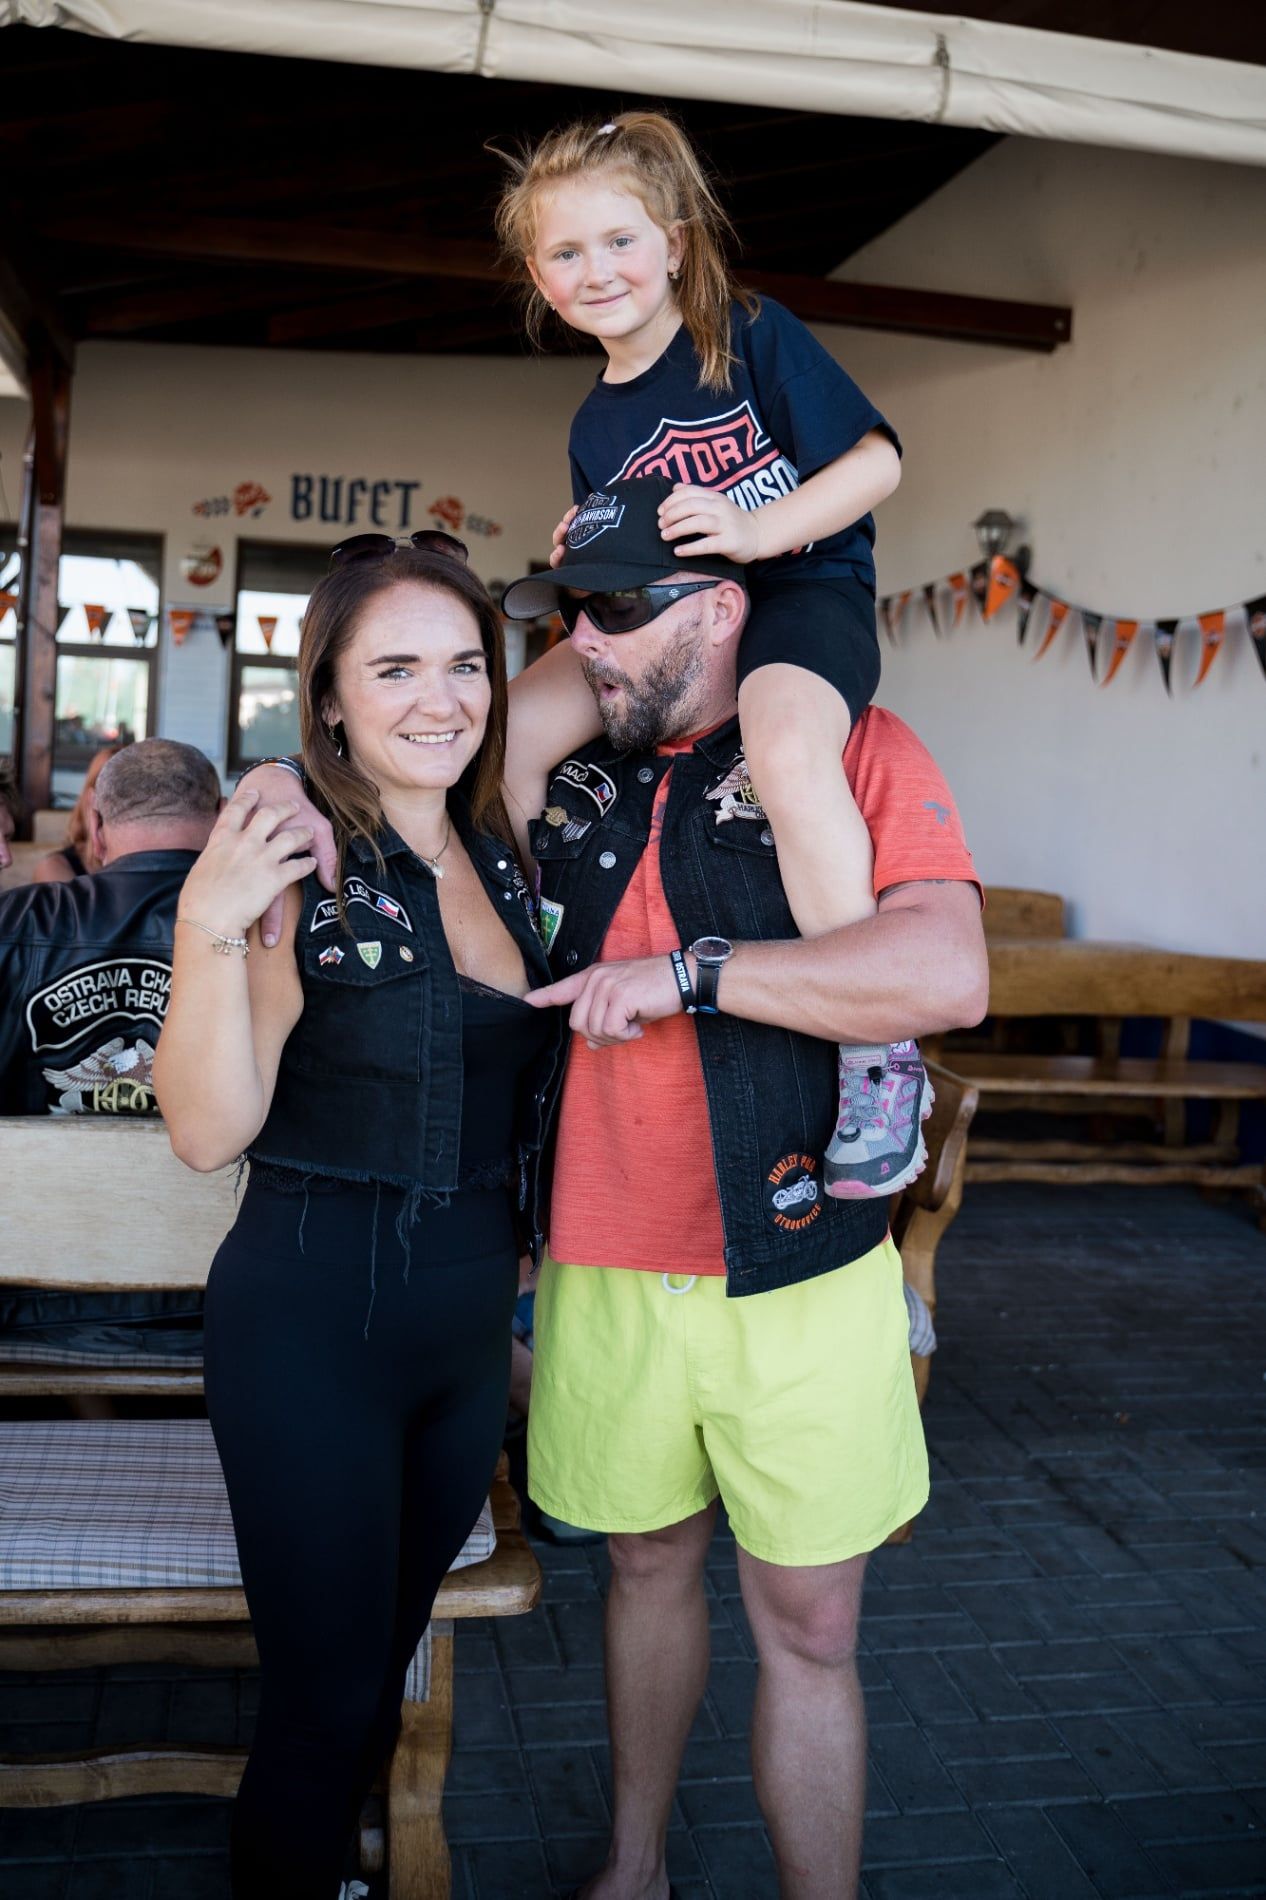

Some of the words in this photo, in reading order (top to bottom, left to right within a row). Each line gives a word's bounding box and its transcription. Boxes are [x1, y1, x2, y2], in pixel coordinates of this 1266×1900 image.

[636, 436, 744, 485] OTOR
[290, 473, 421, 528] BUFET
[349, 884, 371, 901] LISA
[44, 967, 133, 1013] OSTRAVA
[675, 961, 691, 993] OSTRAVA
[52, 991, 118, 1028] CZECH
[767, 1153, 798, 1186] HARLEY
[774, 1202, 822, 1230] OTROKOVICE
